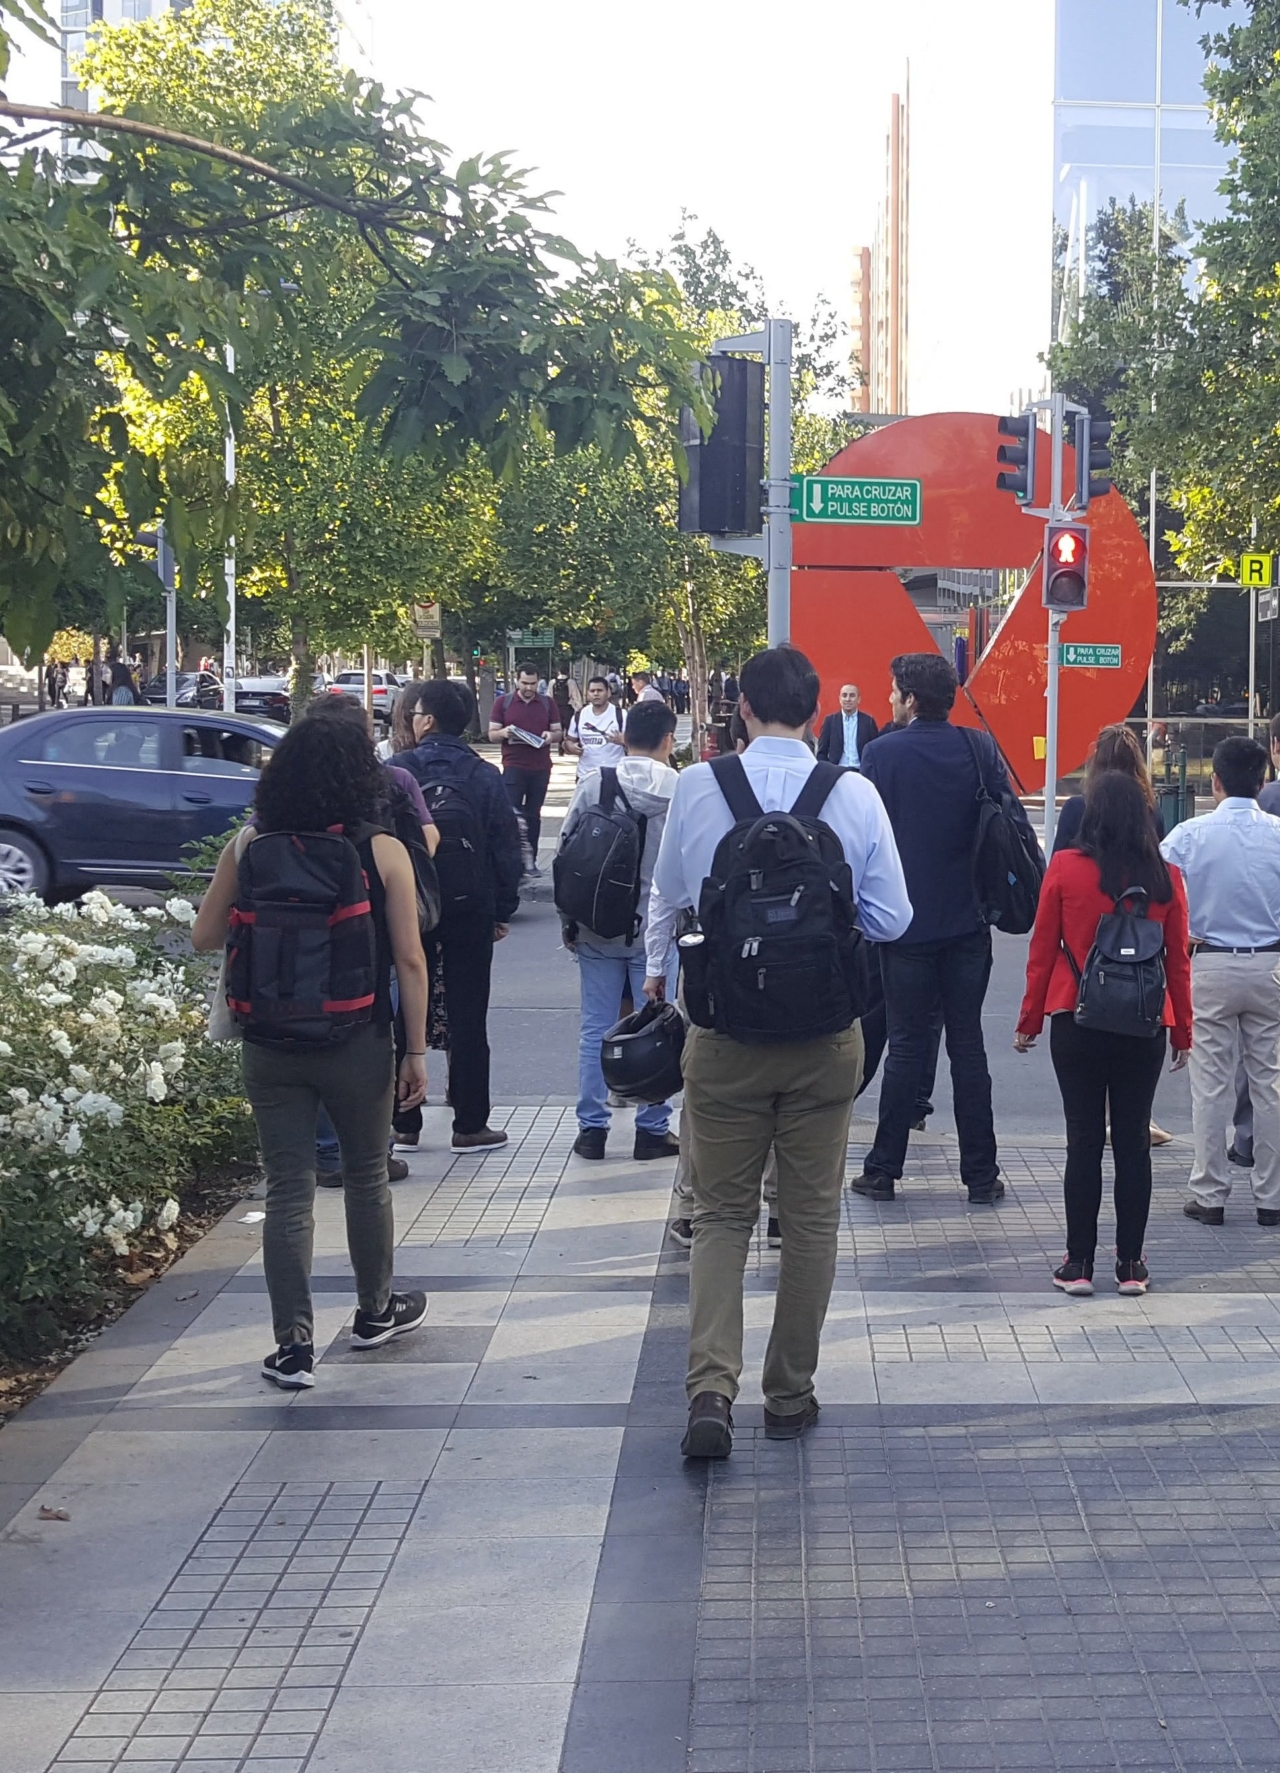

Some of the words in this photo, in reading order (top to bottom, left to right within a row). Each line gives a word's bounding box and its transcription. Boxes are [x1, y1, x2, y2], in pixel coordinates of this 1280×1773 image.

[828, 484, 861, 499] PARA
[863, 485, 911, 500] CRUZAR
[828, 502, 867, 516] PULSE
[870, 501, 911, 518] BOTÓN
[1249, 560, 1264, 582] R
[1077, 647, 1093, 655] PARA
[1099, 655, 1118, 664] BOTÓN
